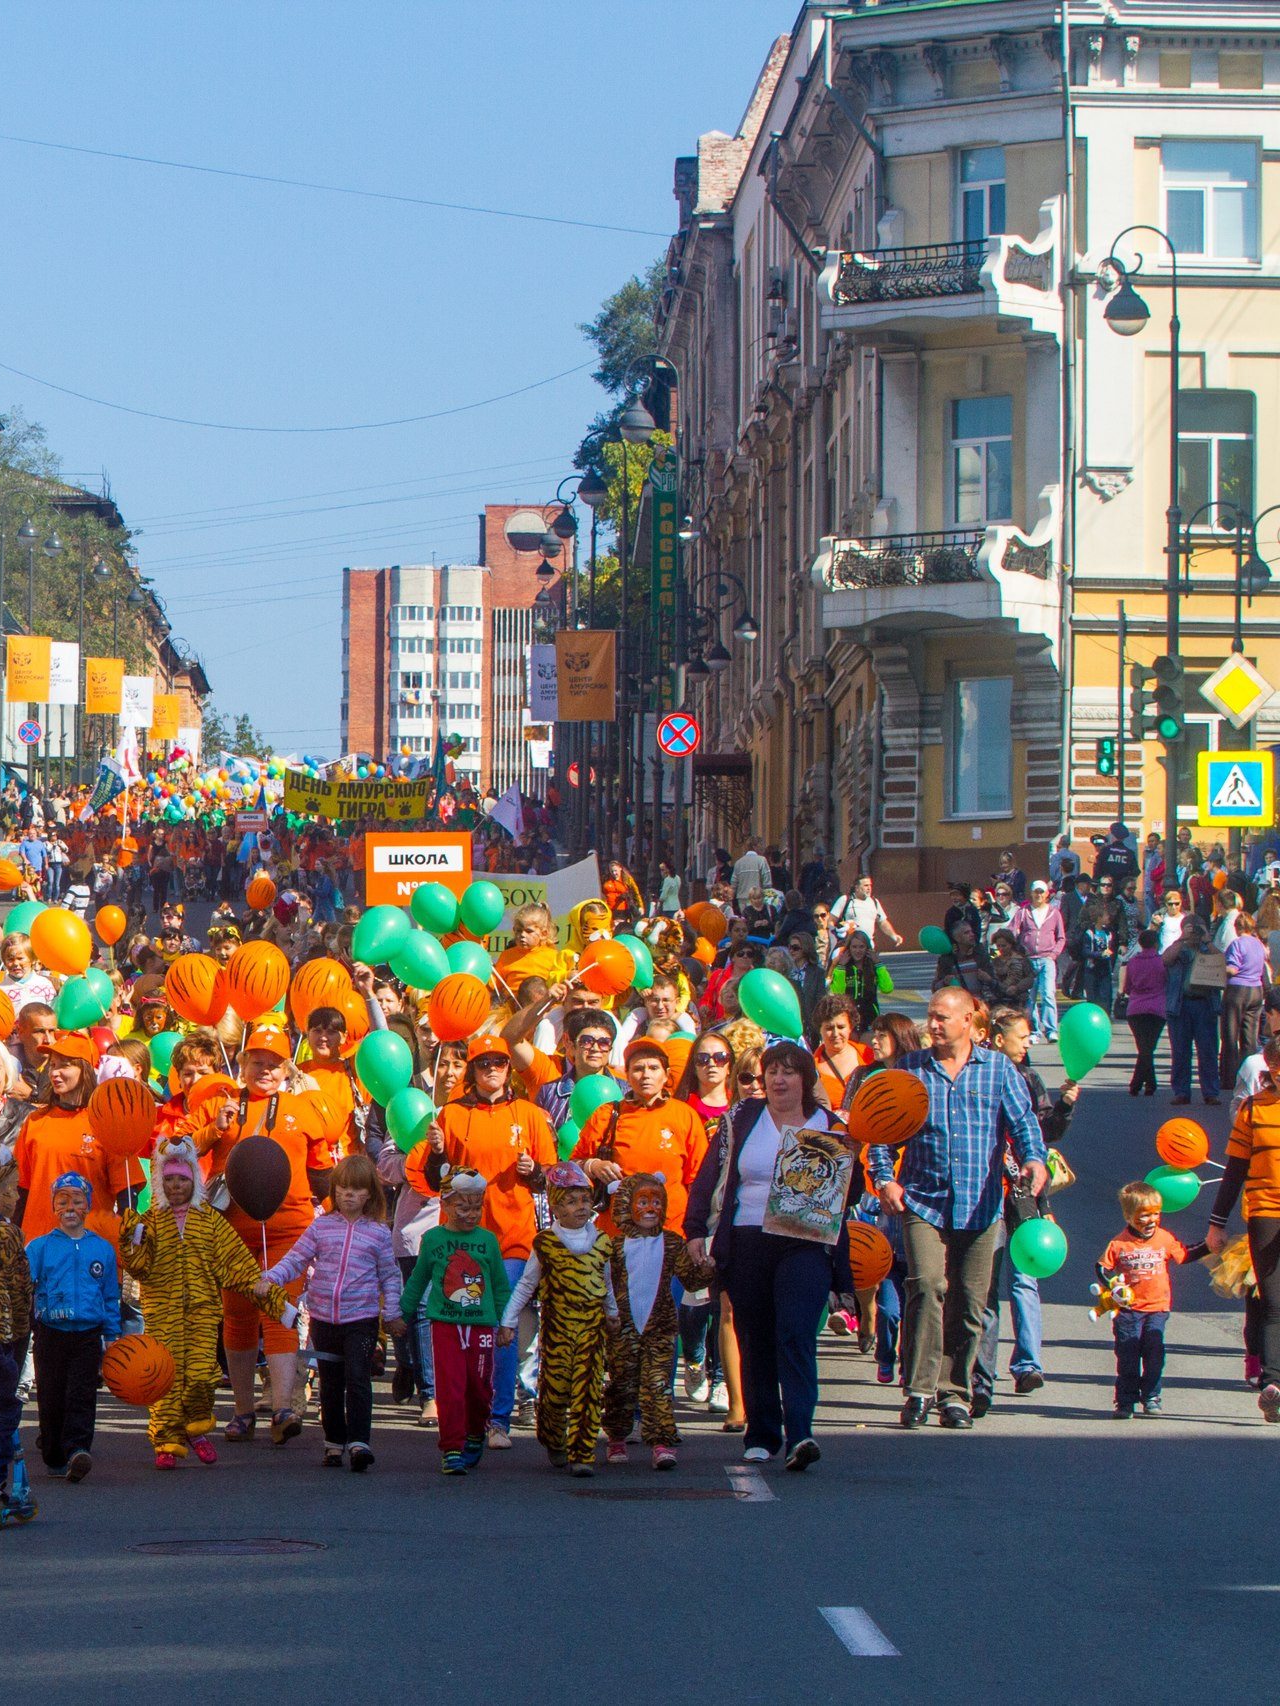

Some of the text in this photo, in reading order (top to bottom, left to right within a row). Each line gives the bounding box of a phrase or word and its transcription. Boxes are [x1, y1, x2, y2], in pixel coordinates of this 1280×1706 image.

[289, 772, 427, 799] ДЕНЬ АМУРСКОГО
[337, 801, 386, 818] ТИГРА
[388, 853, 449, 866] ШКОЛА
[1107, 854, 1128, 864] ДПС
[446, 1240, 487, 1254] Nerd
[478, 1334, 493, 1348] 32
